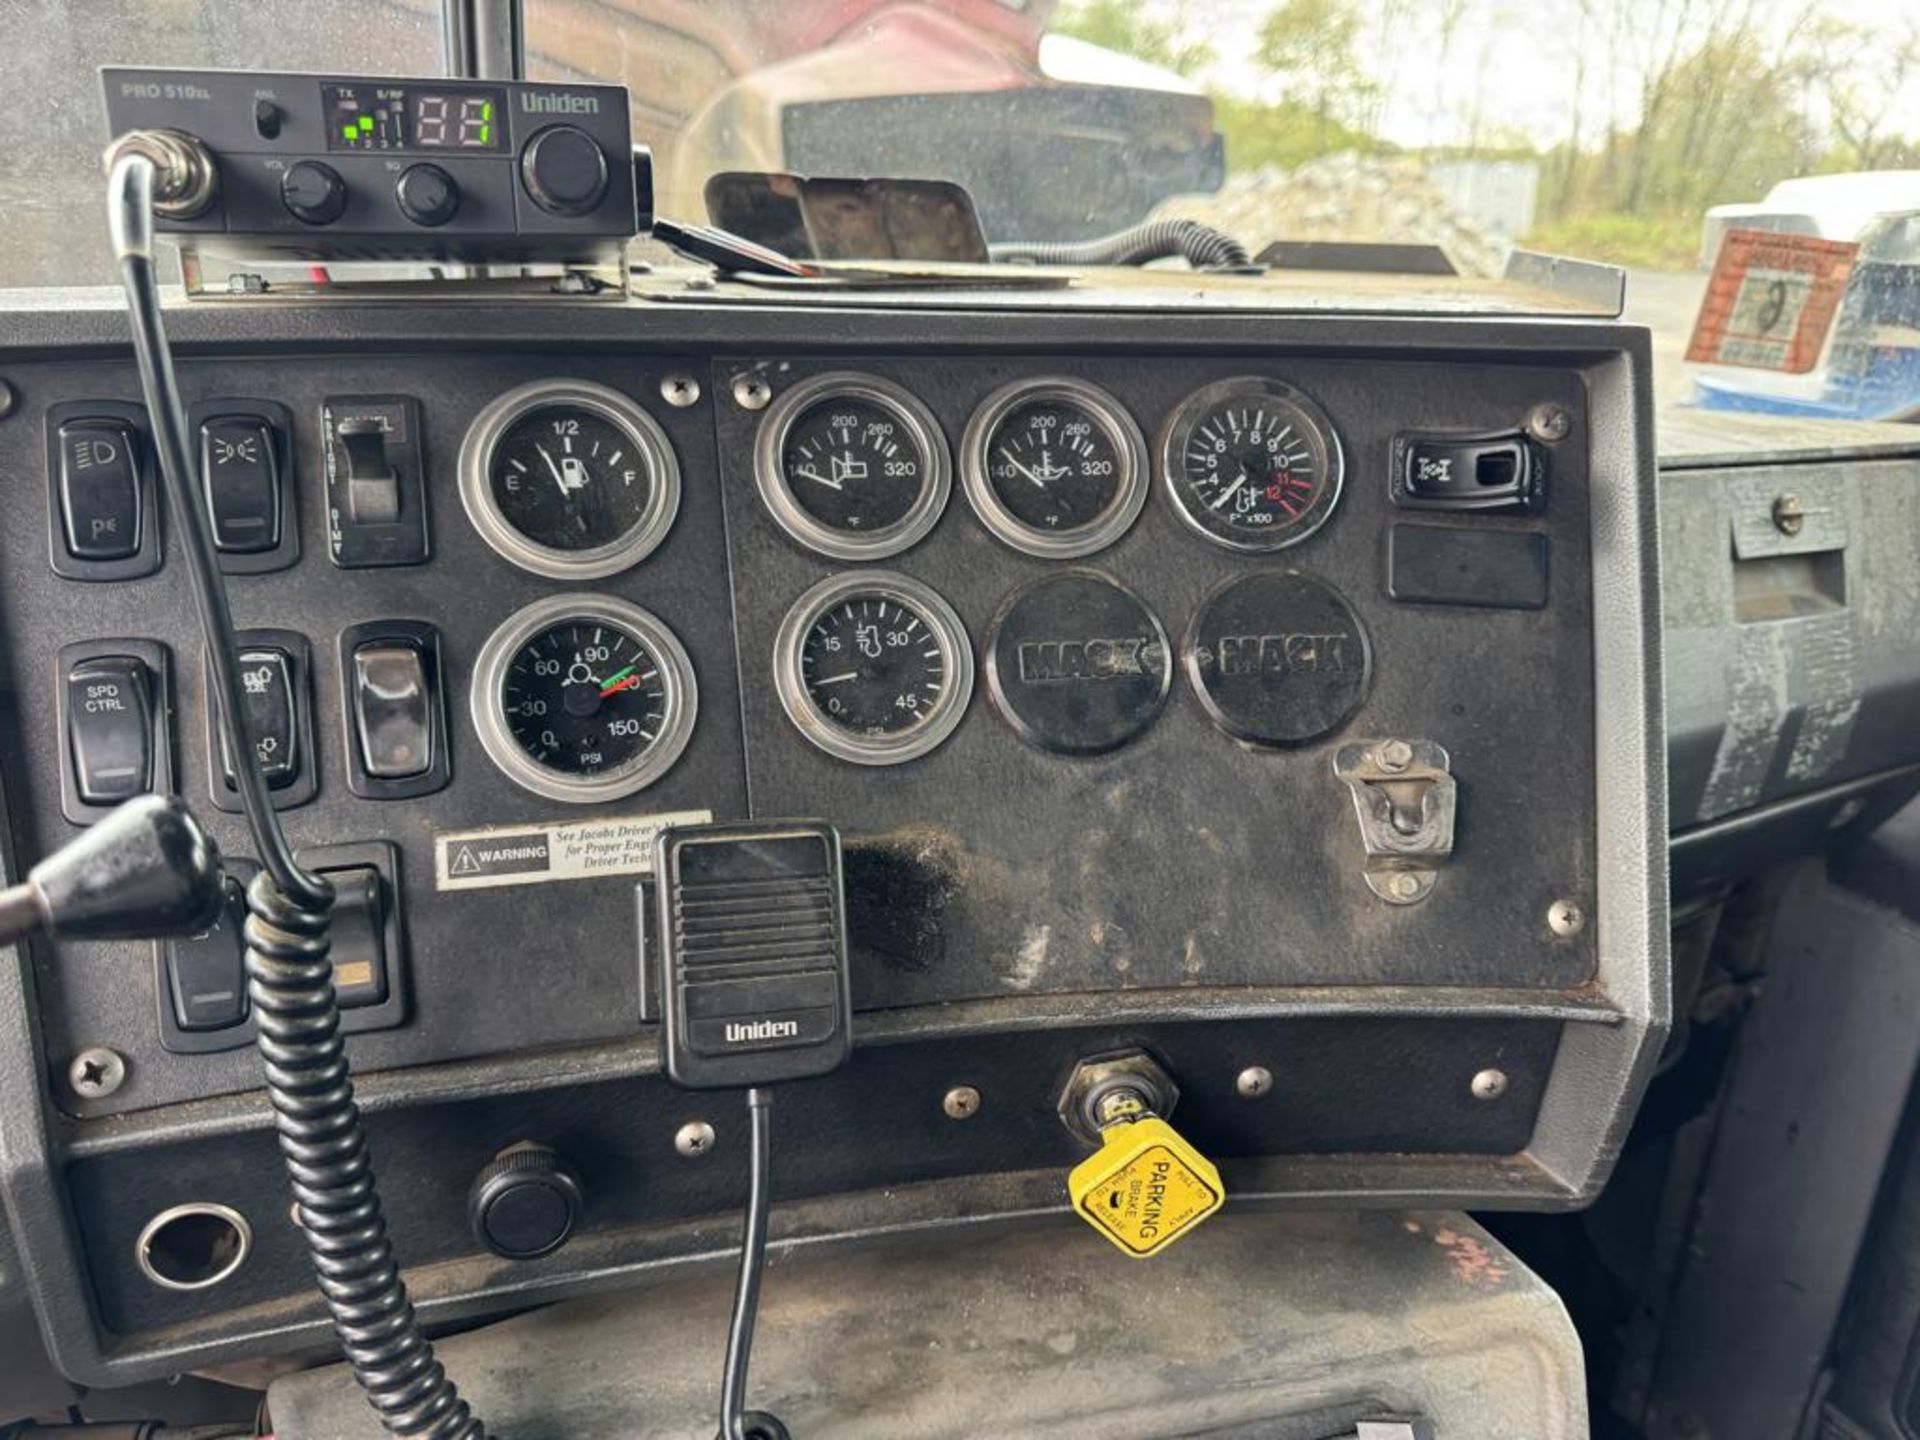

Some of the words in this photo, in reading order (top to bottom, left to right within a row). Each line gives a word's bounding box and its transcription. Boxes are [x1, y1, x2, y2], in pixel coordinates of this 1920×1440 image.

[121, 84, 160, 99] PRO
[521, 92, 599, 114] Uniden
[552, 421, 581, 435] 1/2
[832, 416, 857, 427] 200
[1031, 417, 1056, 428] 200
[1233, 431, 1242, 443] 7
[1250, 431, 1261, 444] 8
[1215, 440, 1226, 453] 6
[1267, 439, 1278, 453] 9
[1081, 462, 1112, 475] 320
[1207, 455, 1217, 468] 5
[1273, 455, 1289, 468] 10
[884, 462, 916, 476] 320
[506, 476, 519, 490] E
[624, 471, 636, 486] F
[1208, 472, 1219, 486] 4
[823, 637, 840, 650] 15
[886, 632, 908, 645] 30
[584, 647, 609, 662] 90
[1019, 639, 1150, 684] MACK
[1220, 634, 1348, 675] MACK
[534, 660, 560, 675] 60
[87, 685, 118, 698] SPD
[85, 699, 126, 712] CTRL
[829, 698, 840, 712] 0
[895, 694, 917, 708] 45
[521, 701, 546, 716] 30
[607, 719, 639, 736] 150
[541, 730, 554, 745] 0
[581, 752, 602, 764] PSI
[626, 839, 650, 851] Engi
[479, 846, 547, 863] WARNING
[725, 1021, 798, 1042] Uniden
[1124, 1179, 1143, 1218] BRAKE
[1139, 1161, 1170, 1239] PARKING
